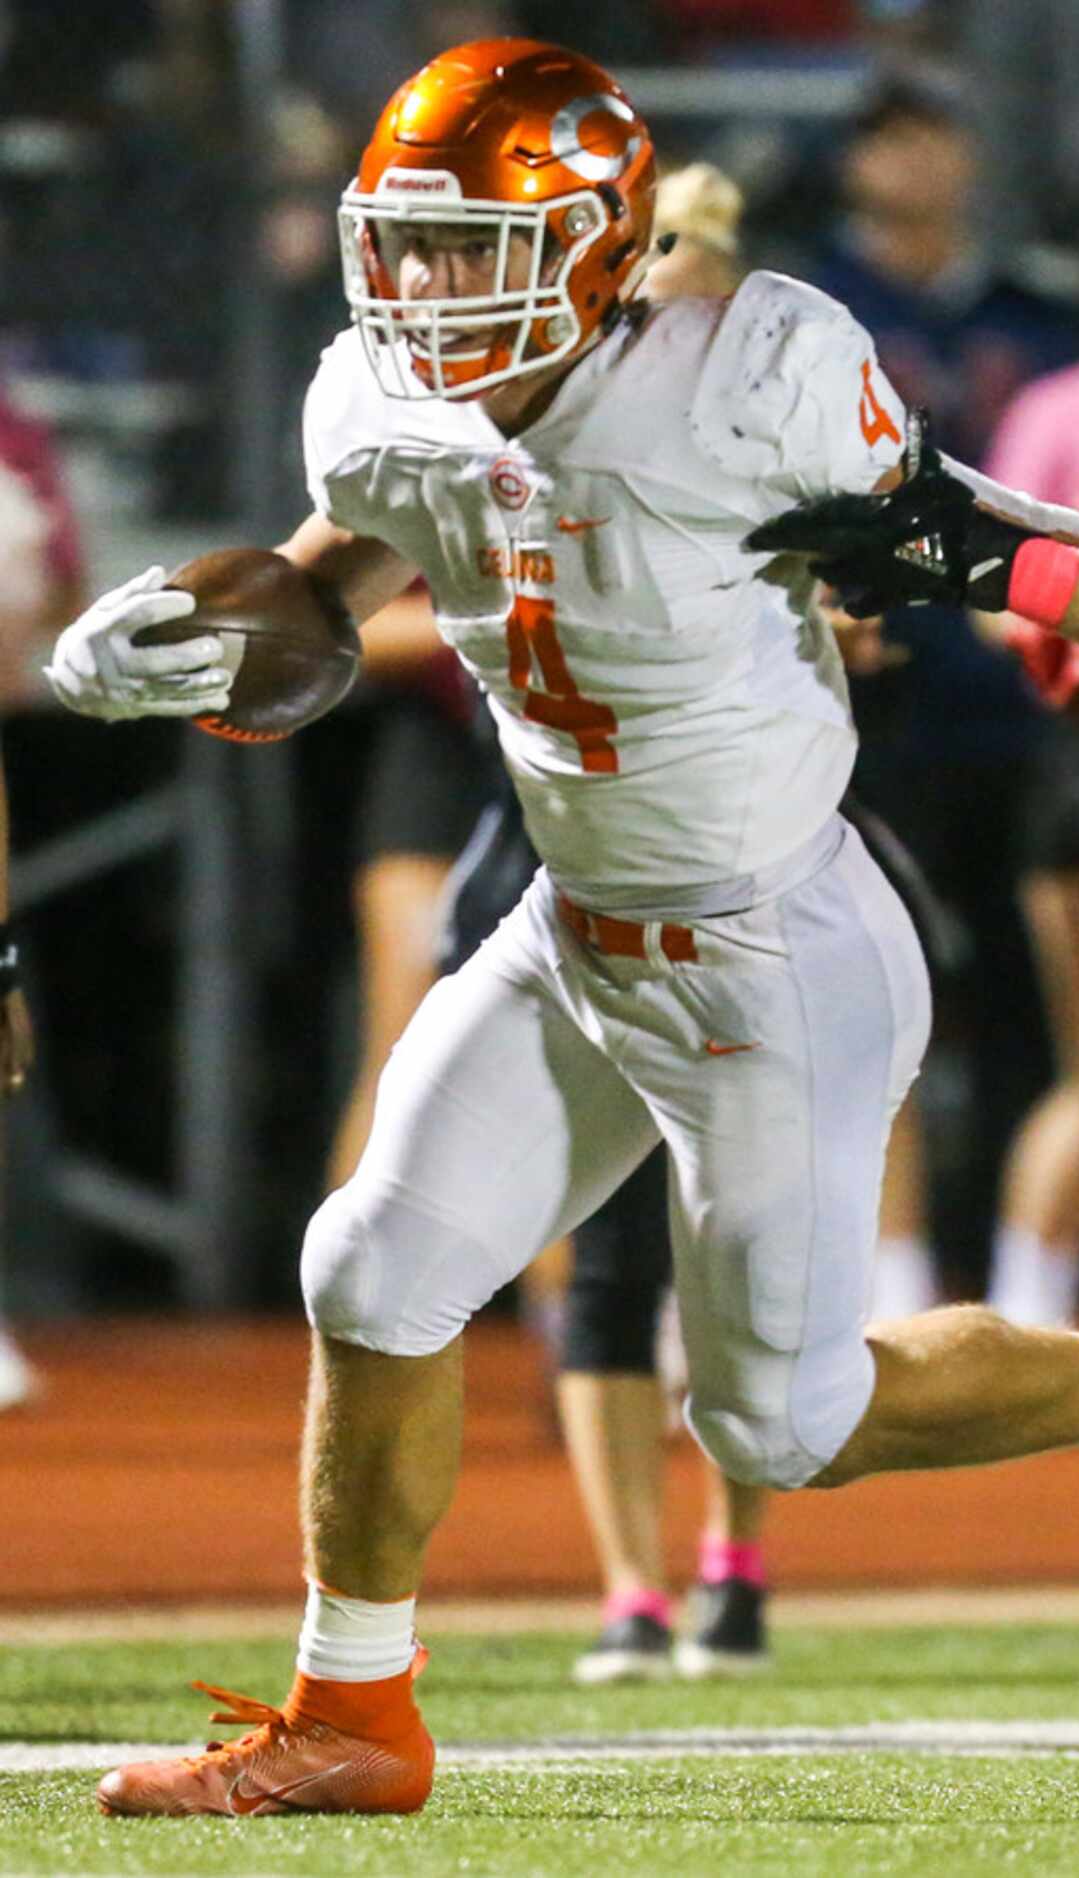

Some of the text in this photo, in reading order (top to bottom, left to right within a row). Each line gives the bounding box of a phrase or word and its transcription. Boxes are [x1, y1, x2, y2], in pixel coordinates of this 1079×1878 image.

[551, 94, 642, 182] C
[857, 358, 902, 448] 4
[506, 594, 620, 774] 4
